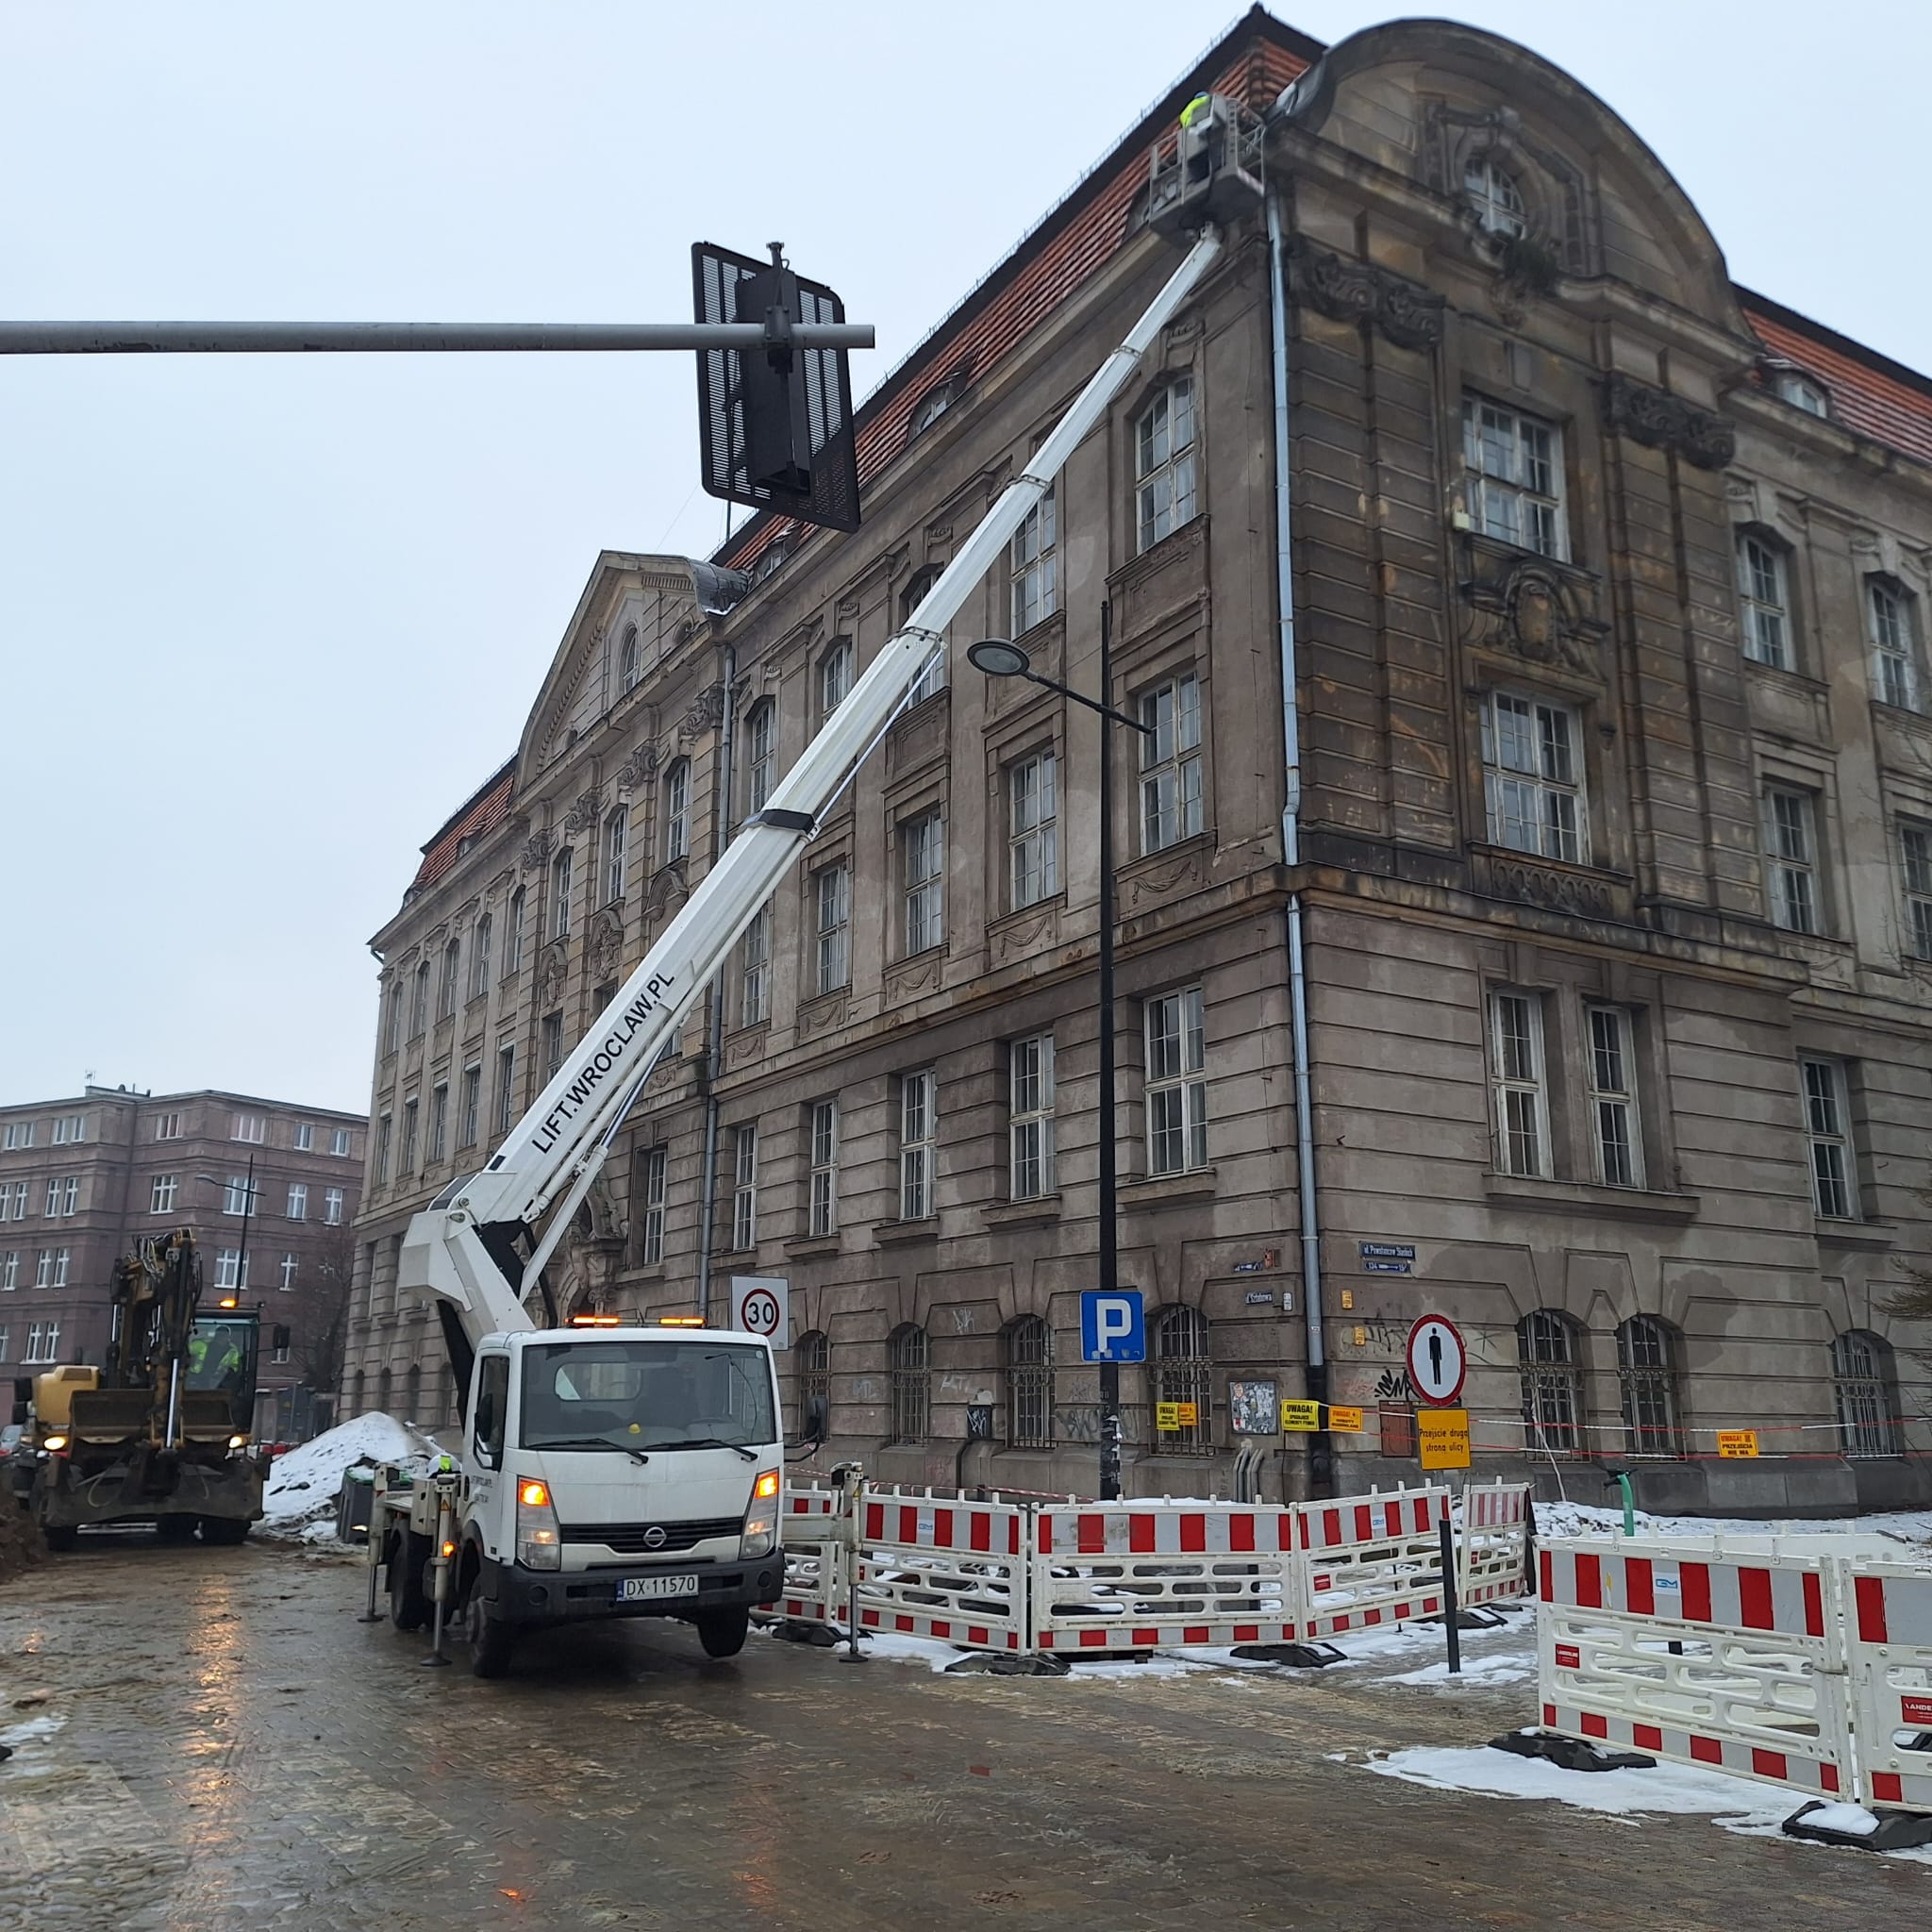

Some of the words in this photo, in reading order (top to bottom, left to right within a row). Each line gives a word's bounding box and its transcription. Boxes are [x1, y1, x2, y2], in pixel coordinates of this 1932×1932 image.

[531, 973, 675, 1155] LIFT.WROCLAW.PL
[748, 1302, 774, 1324] 30
[1096, 1298, 1132, 1353] P
[1286, 1404, 1313, 1413] UWAGA!
[1449, 1441, 1464, 1455] ulicy
[626, 1580, 646, 1596] DX
[652, 1576, 695, 1594] 11570
